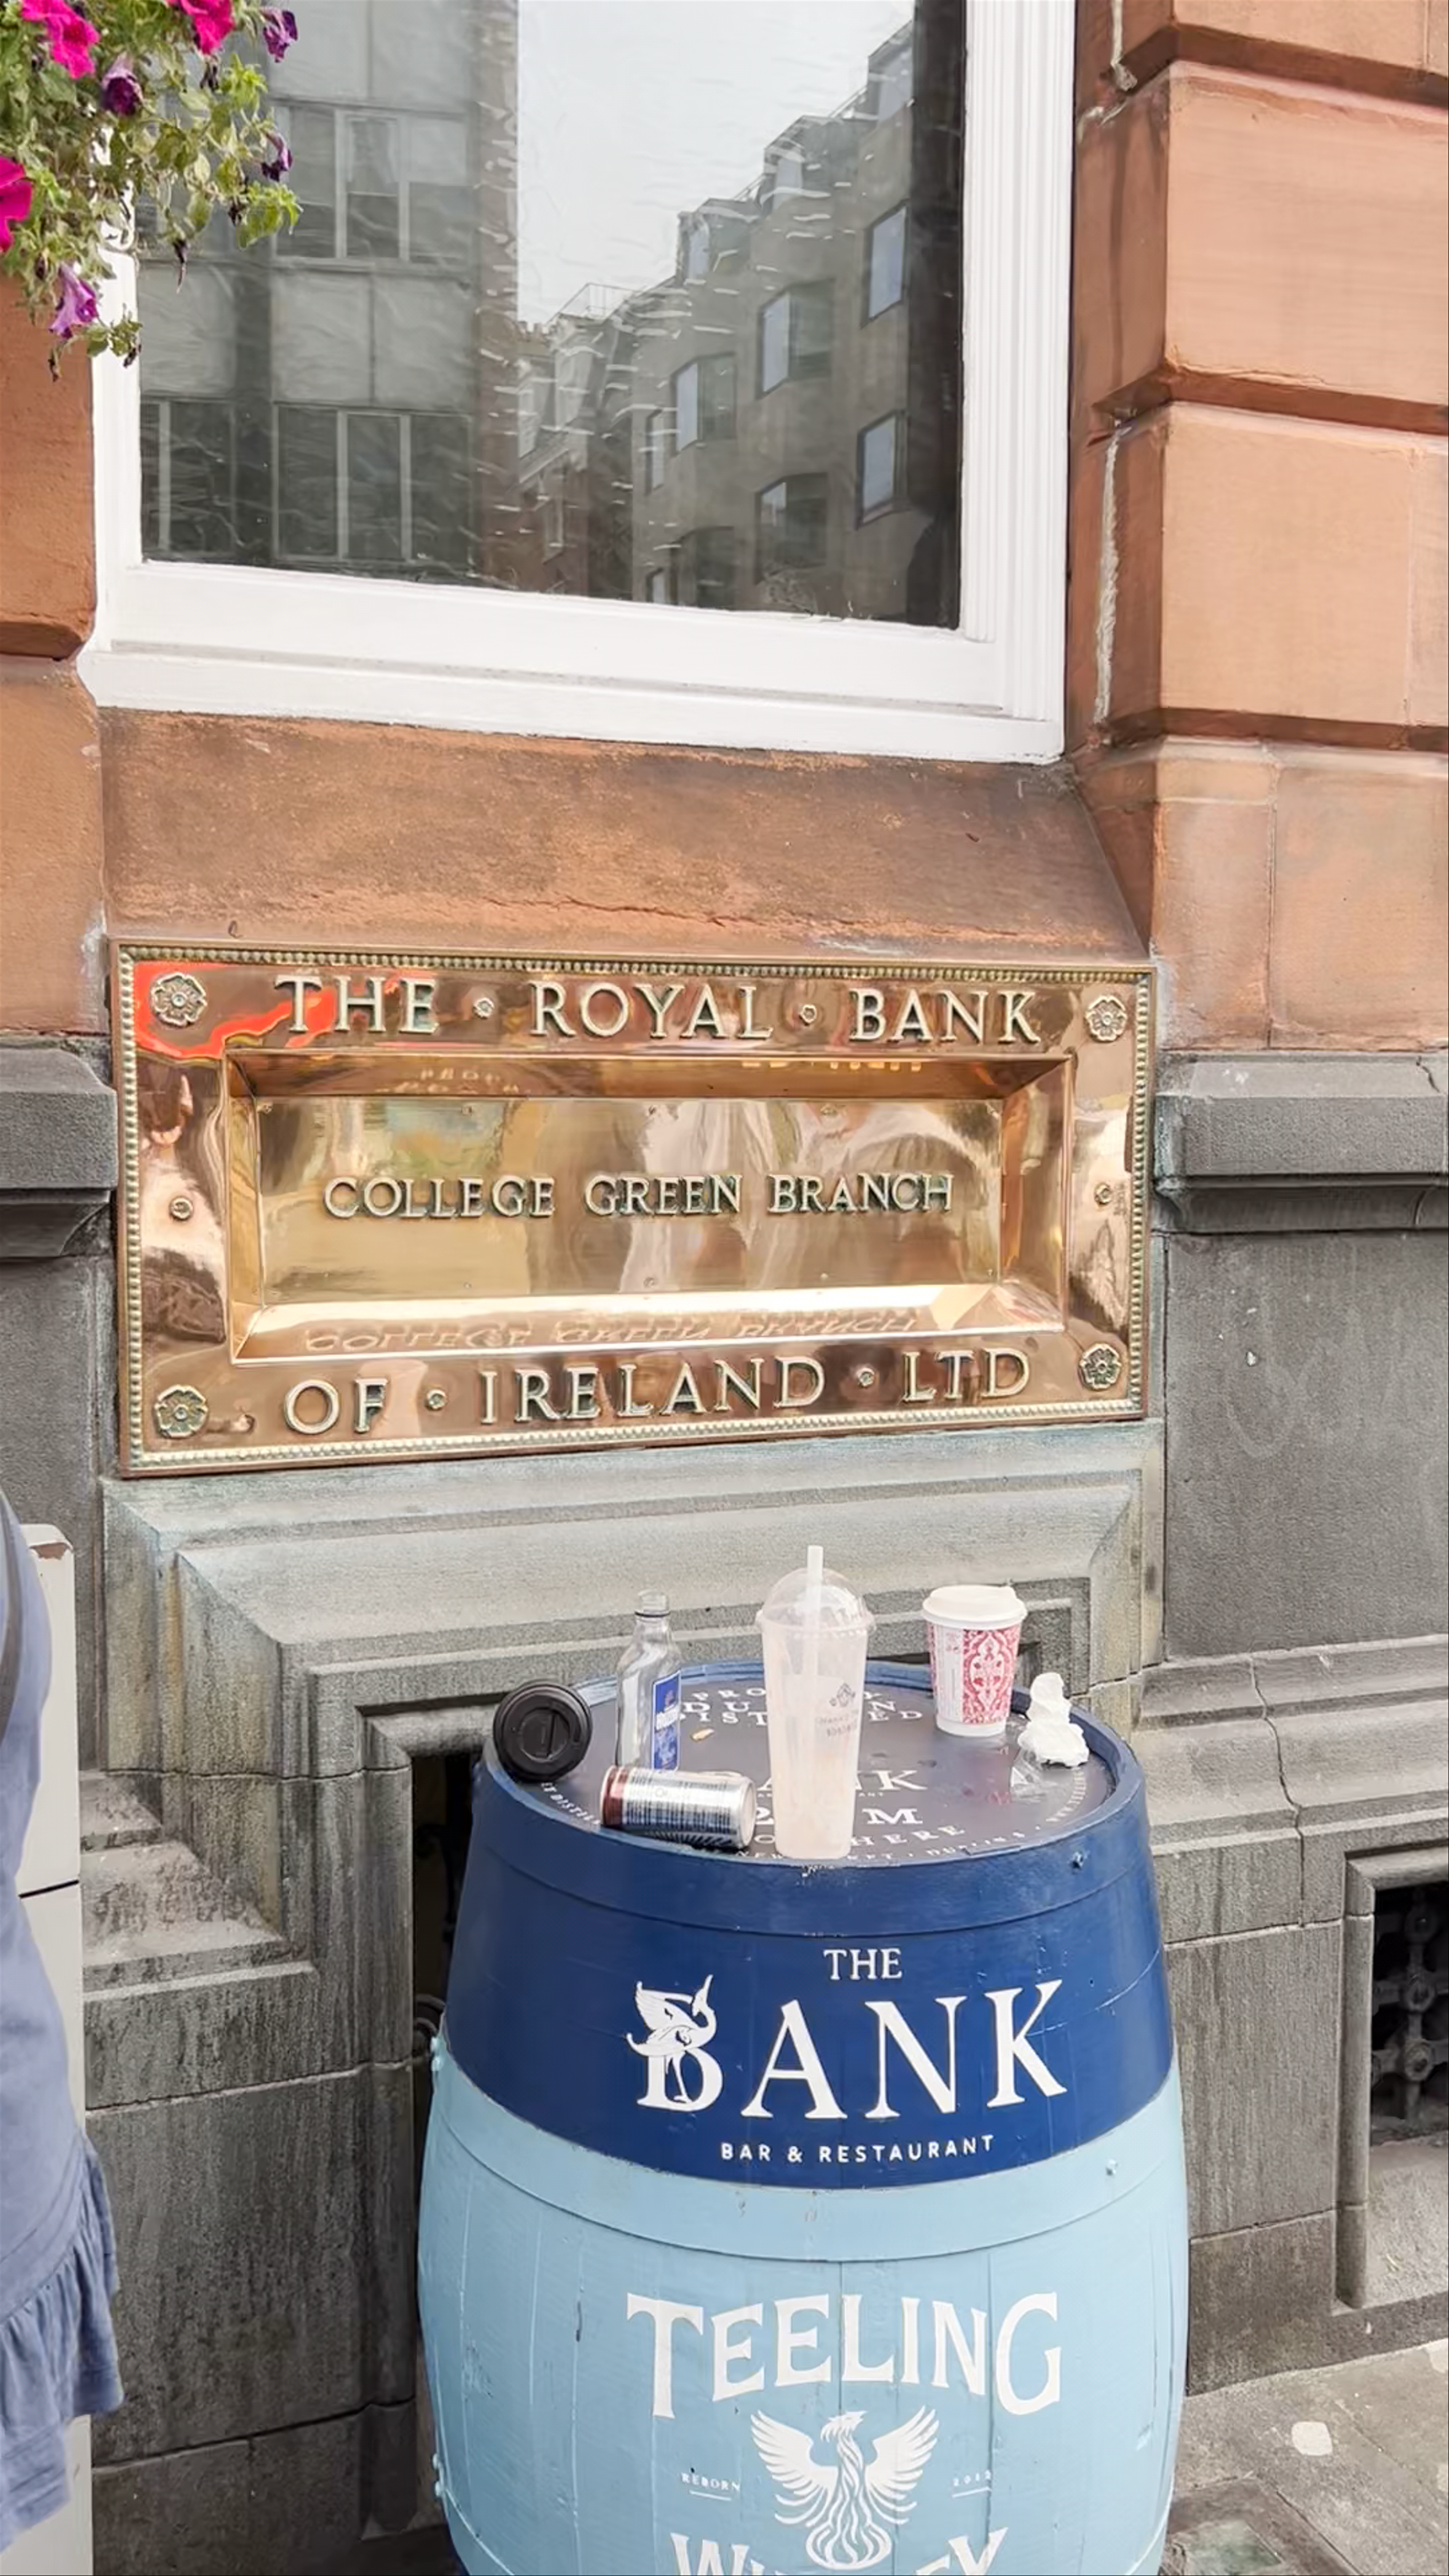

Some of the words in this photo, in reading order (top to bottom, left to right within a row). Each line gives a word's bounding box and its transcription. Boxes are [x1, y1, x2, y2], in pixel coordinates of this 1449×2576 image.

[274, 974, 439, 1034] THE
[529, 981, 774, 1039] ROYAL
[849, 988, 1040, 1044] BANK
[323, 1176, 555, 1219] COLLEGE
[585, 1174, 743, 1216] GREEN
[768, 1172, 954, 1213] BRANCH
[284, 1377, 388, 1434] OF
[480, 1355, 825, 1425] IRELAND
[901, 1347, 1030, 1403] LTD
[823, 1948, 903, 1981] THE
[626, 1974, 1068, 2121] BANK
[721, 2142, 773, 2163] BAR
[787, 2147, 803, 2163] &
[819, 2134, 995, 2163] RESTAURANT
[626, 2292, 1063, 2419] TEELING
[681, 2472, 741, 2491] REBORN
